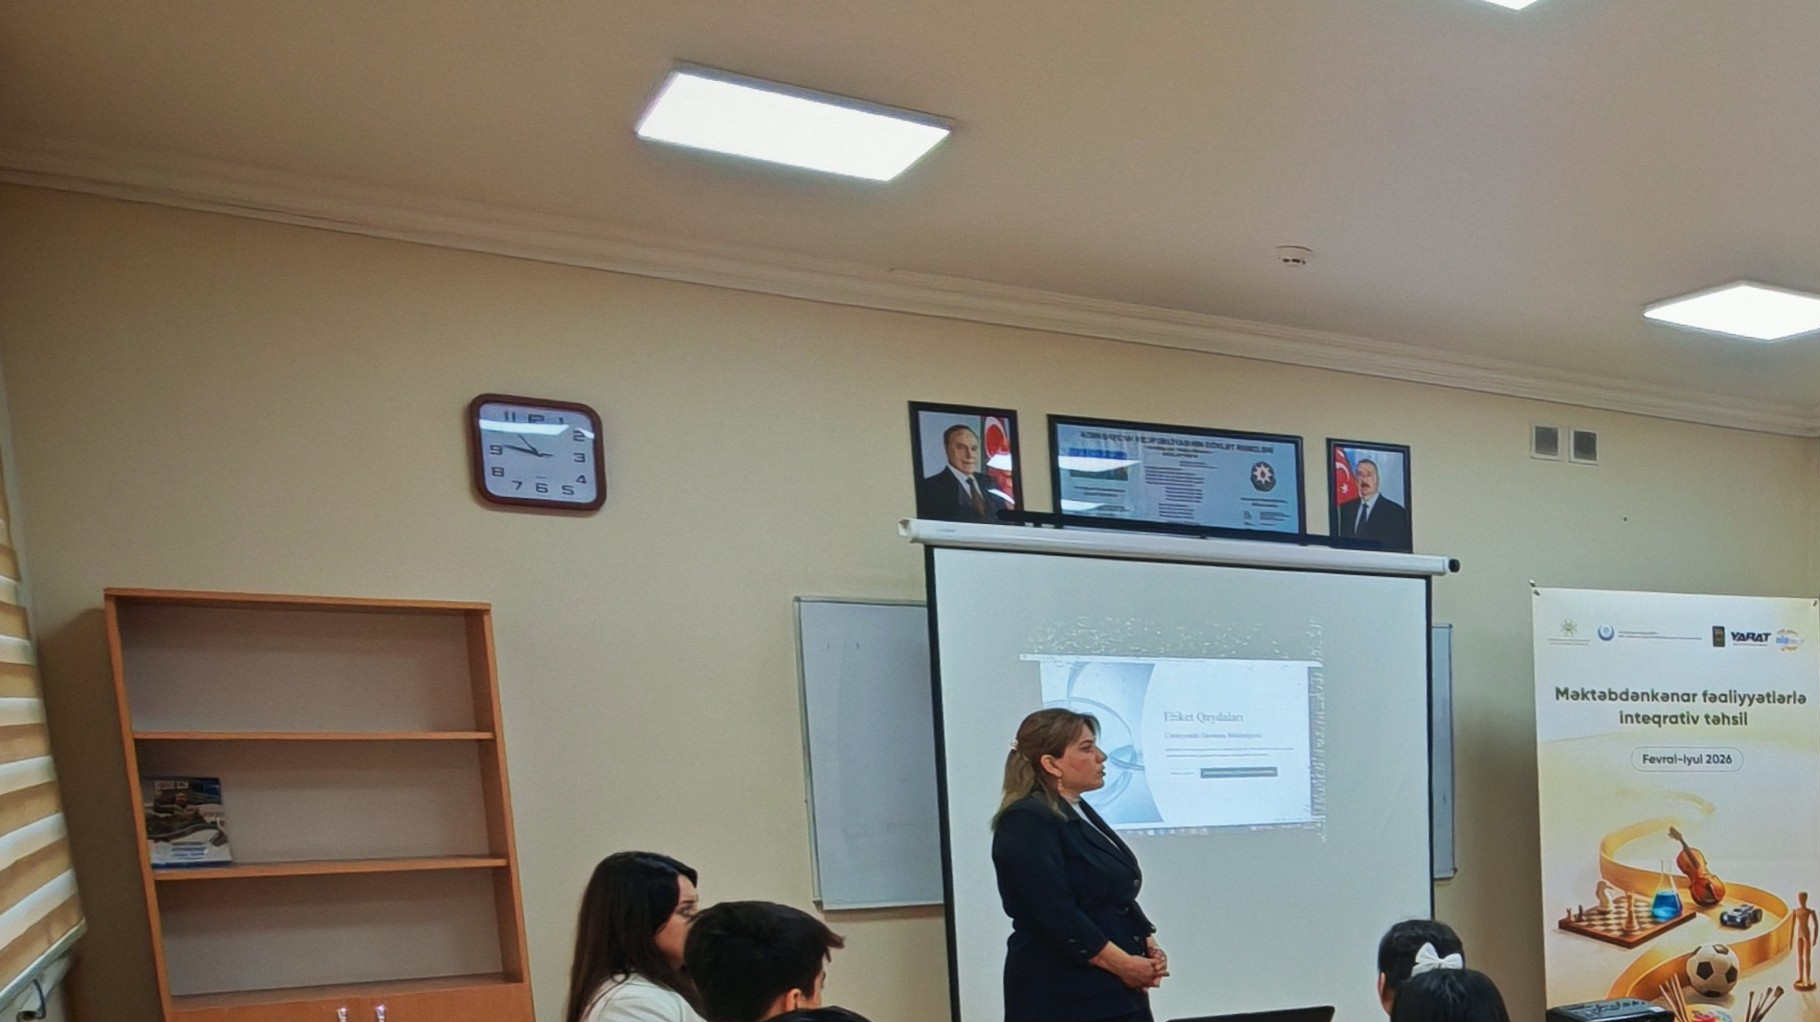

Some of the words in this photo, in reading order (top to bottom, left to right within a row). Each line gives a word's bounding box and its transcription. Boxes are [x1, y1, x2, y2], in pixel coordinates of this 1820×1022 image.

[490, 444, 503, 456] 9
[573, 452, 586, 463] 3
[491, 466, 505, 478] 8
[511, 480, 523, 491] 7
[575, 474, 587, 485] 4
[535, 482, 549, 494] 6
[561, 484, 575, 496] 5
[1730, 631, 1772, 643] YARAT
[1554, 686, 1698, 704] Məktəbdənkənar
[1702, 689, 1807, 707] fəaliyyətlərlə
[1704, 711, 1748, 726] təhsil
[1705, 753, 1733, 765] 2026
